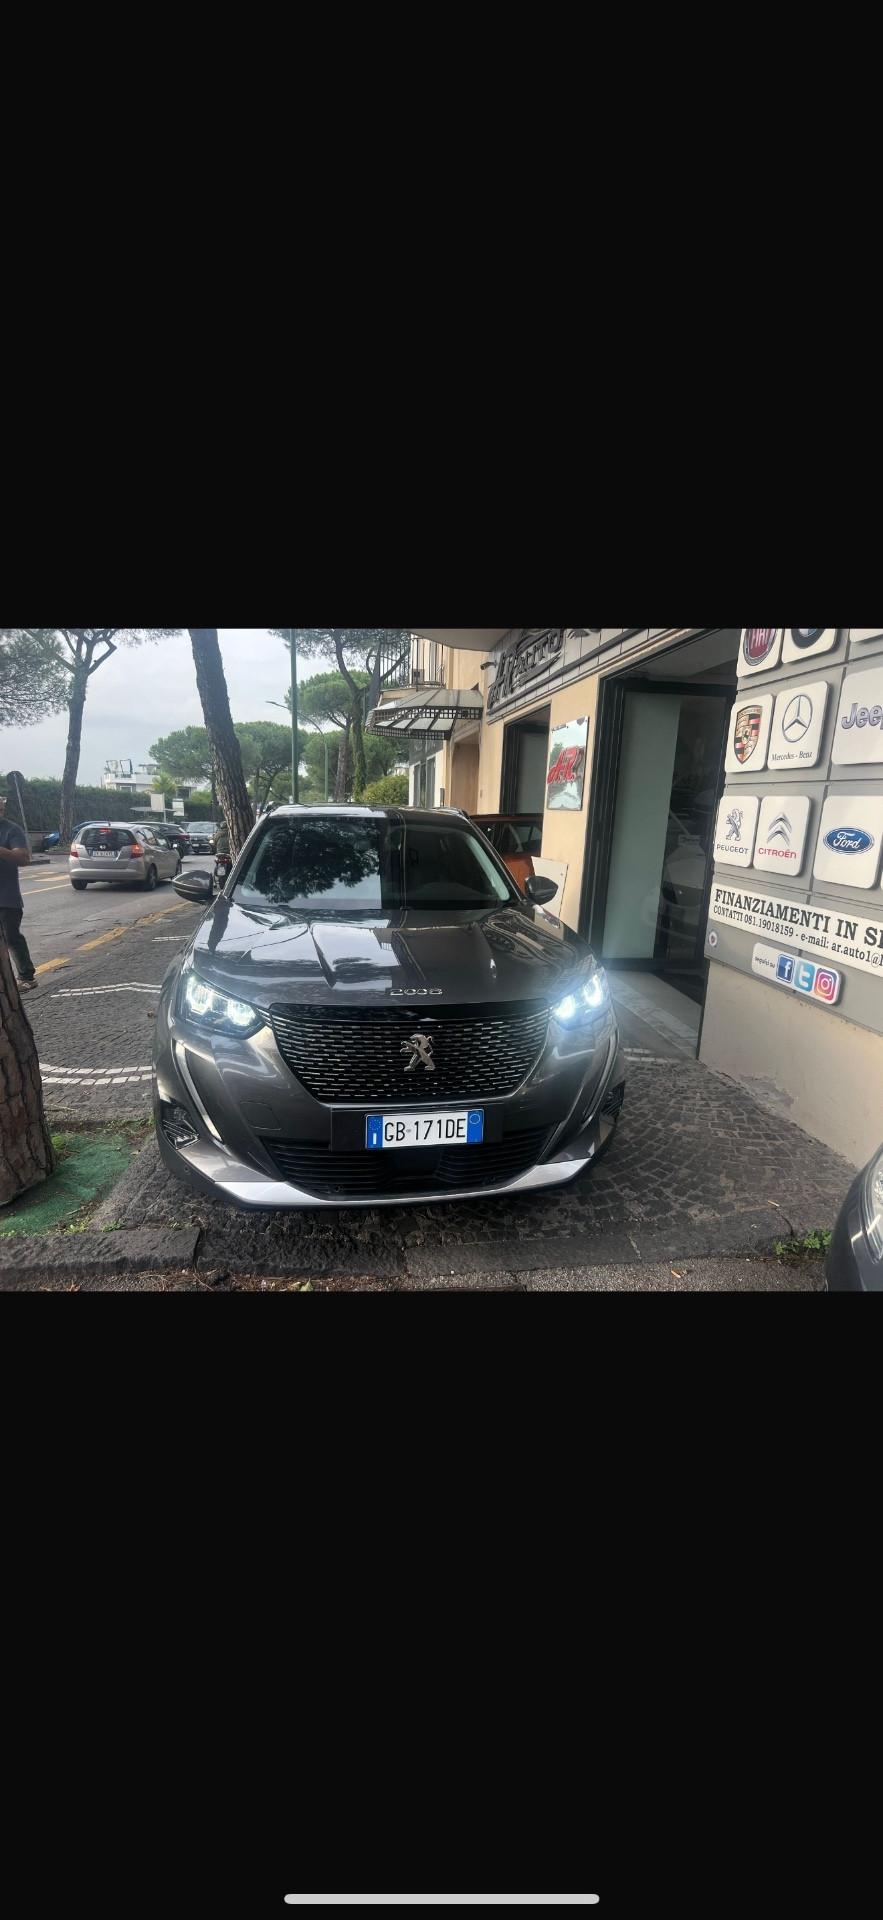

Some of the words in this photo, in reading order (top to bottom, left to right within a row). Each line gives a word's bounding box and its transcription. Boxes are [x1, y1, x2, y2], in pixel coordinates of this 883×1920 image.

[841, 702, 883, 730] Jee
[716, 843, 749, 854] PEUGEOT
[832, 831, 862, 850] Ford
[714, 888, 831, 933] FINANZIAMENTI
[835, 918, 858, 940] IN
[713, 905, 743, 922] CONTATTI
[744, 915, 794, 937] 081.19018159
[800, 932, 829, 949] e-mail:
[390, 988, 443, 996] 2008
[414, 1118, 466, 1141] 171DE
